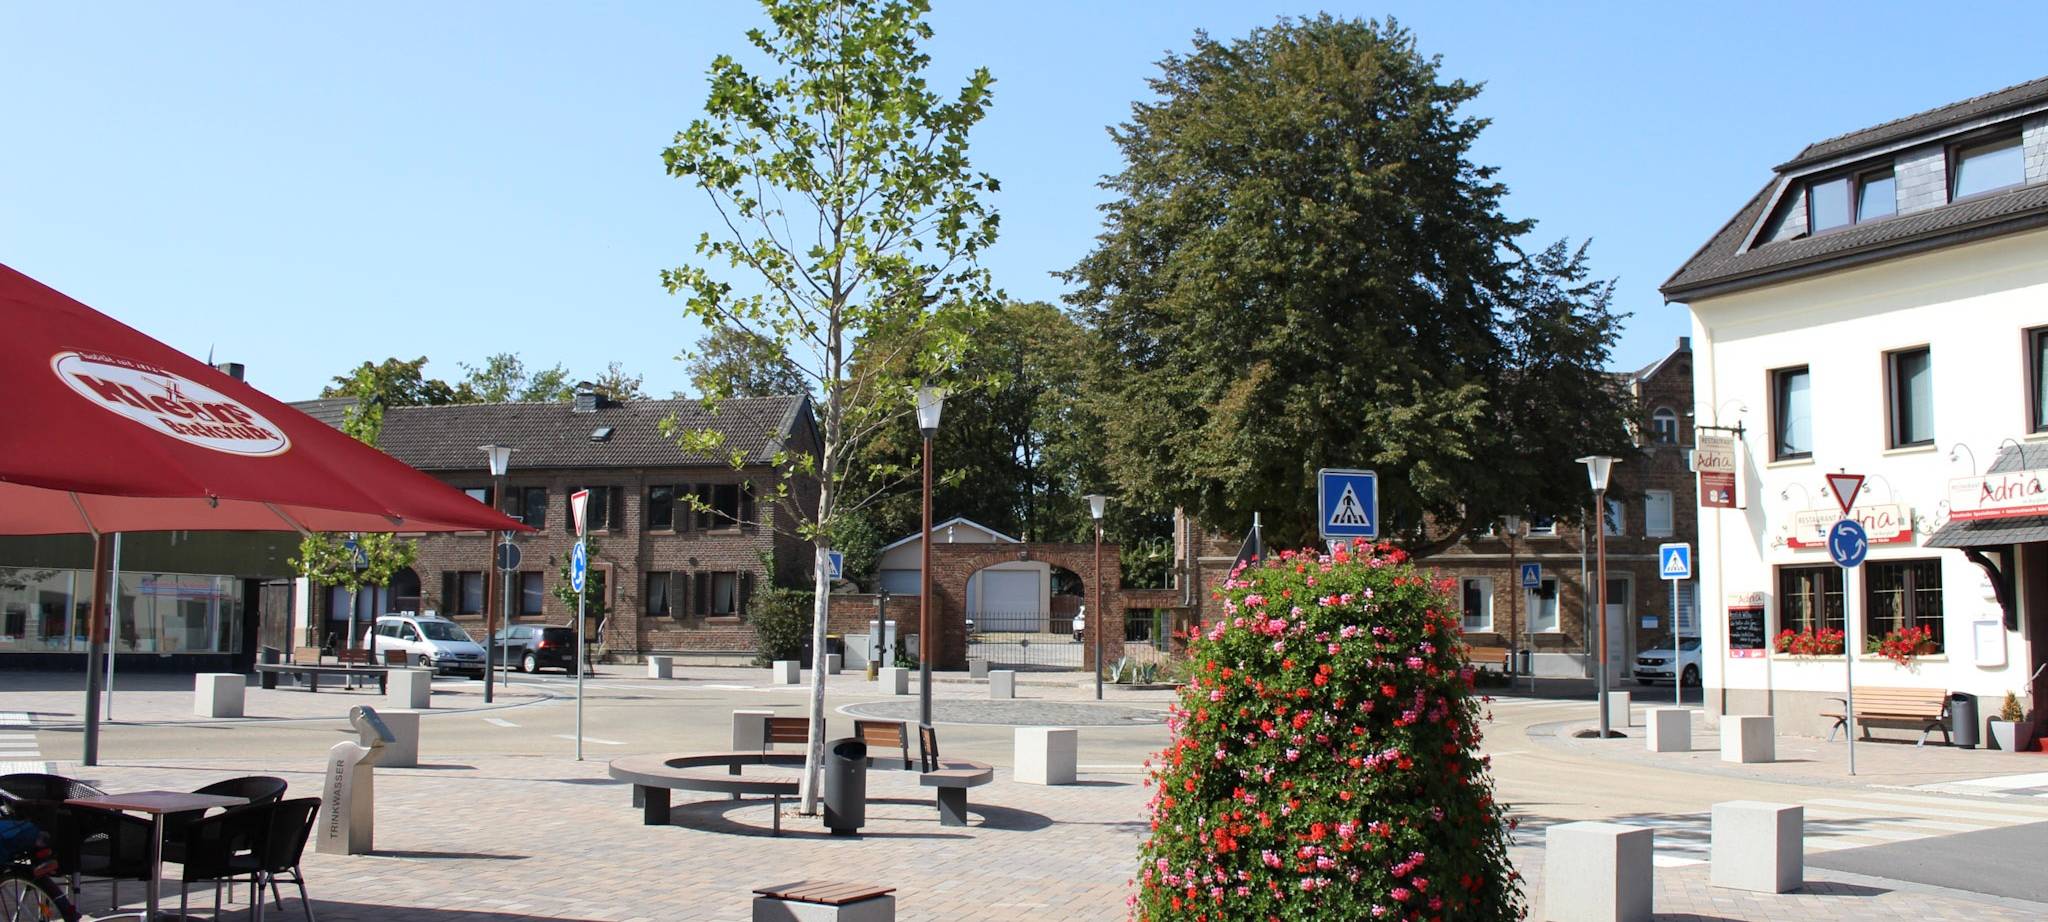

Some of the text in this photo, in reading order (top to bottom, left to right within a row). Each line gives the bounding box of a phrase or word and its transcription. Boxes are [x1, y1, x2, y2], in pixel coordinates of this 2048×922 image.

[157, 417, 280, 440] Backstube
[1697, 450, 1732, 468] Adria
[1979, 474, 2046, 508] Adria
[1798, 514, 1837, 523] RESTAURANT
[330, 759, 345, 840] TRINKWASSER
